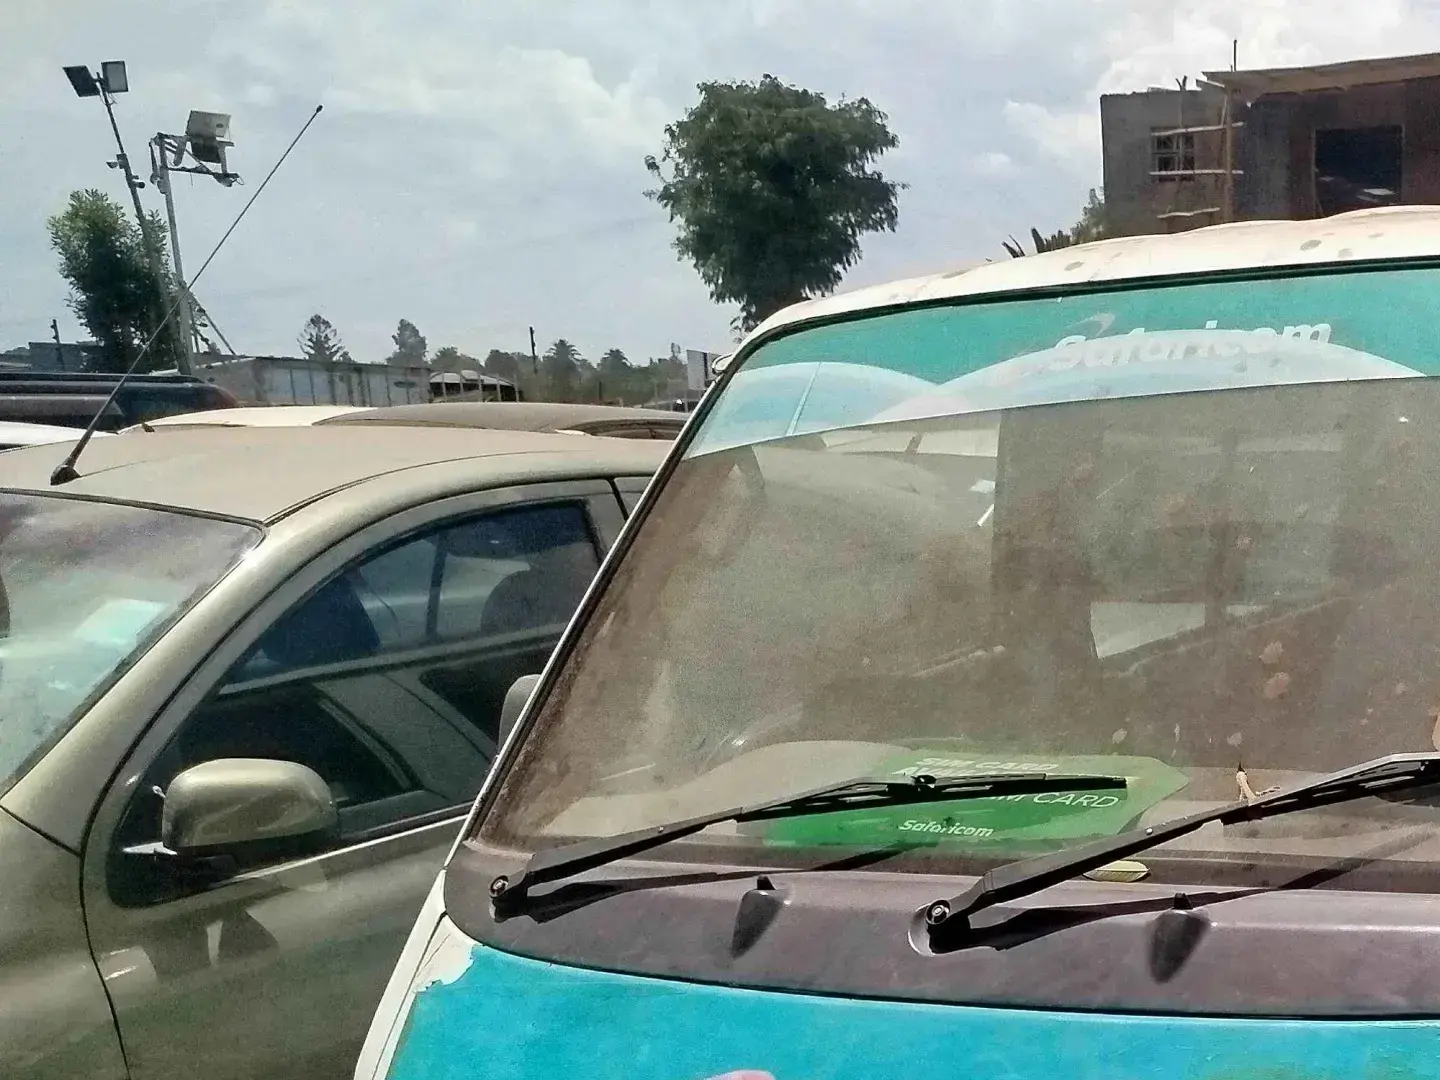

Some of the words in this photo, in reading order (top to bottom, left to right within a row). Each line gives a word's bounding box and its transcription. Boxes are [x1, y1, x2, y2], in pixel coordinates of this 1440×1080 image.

[1046, 320, 1335, 369] Safaricom
[1033, 792, 1119, 808] CARD
[899, 819, 993, 837] Safaricom
